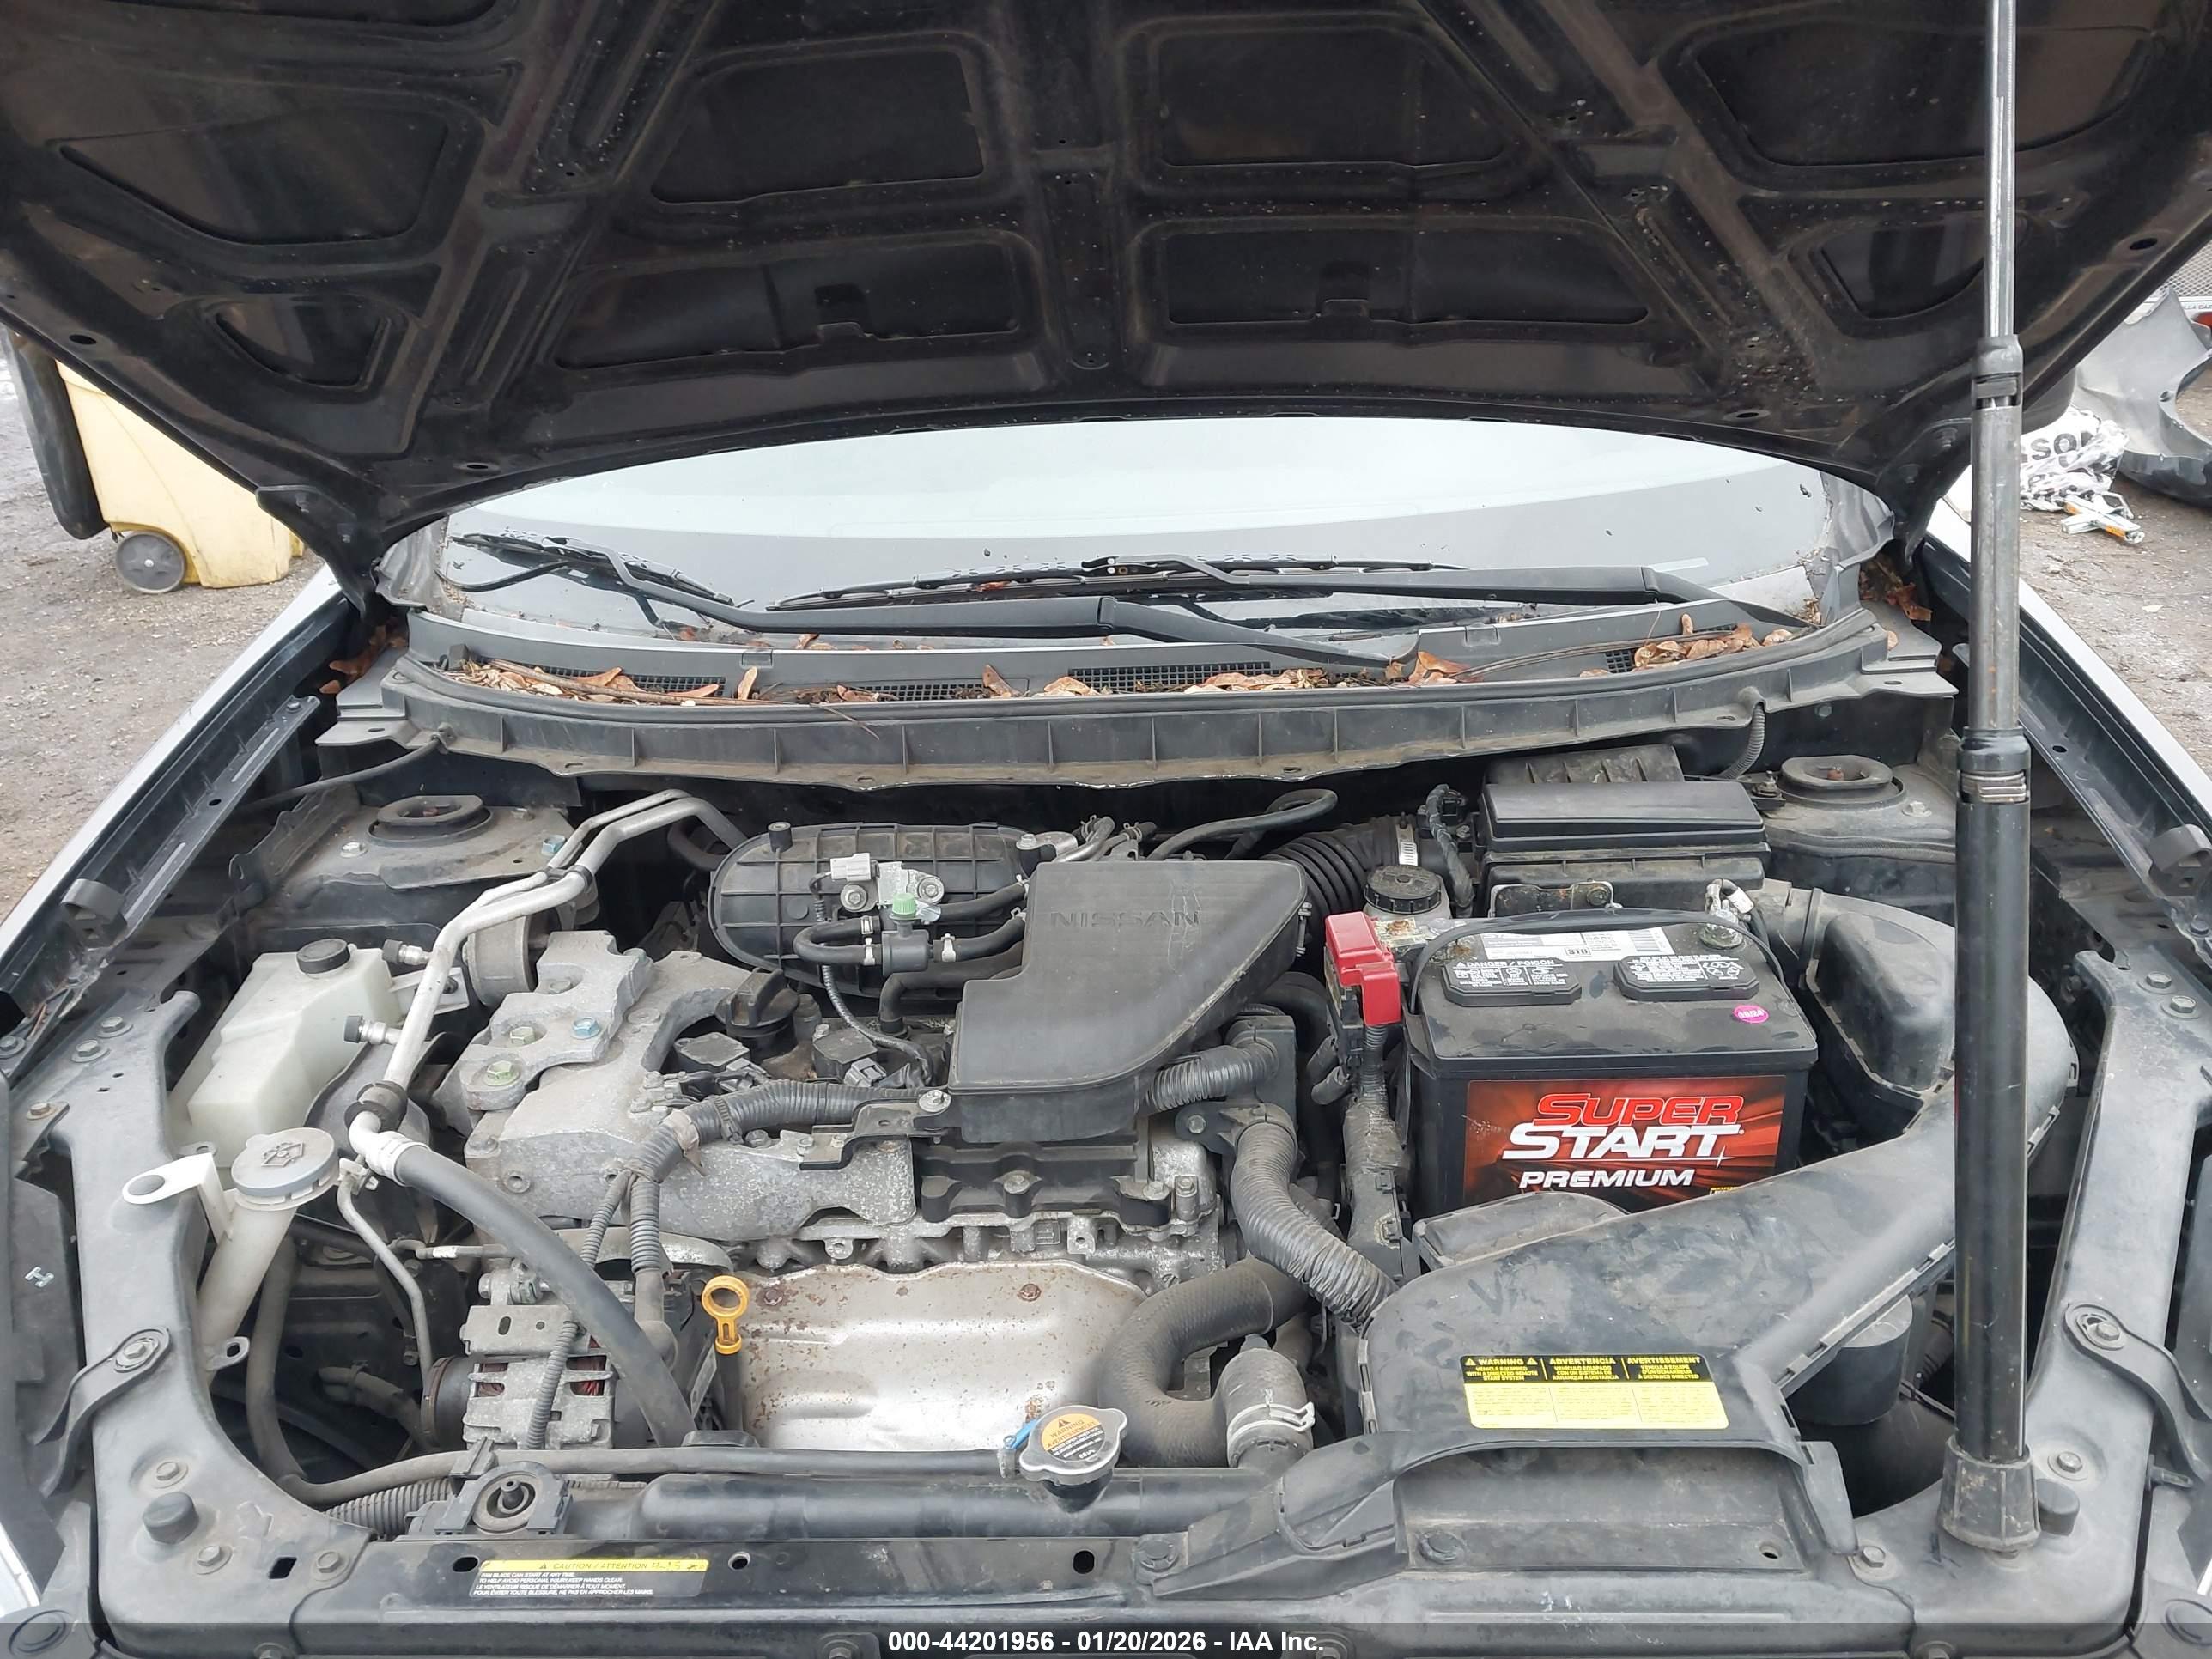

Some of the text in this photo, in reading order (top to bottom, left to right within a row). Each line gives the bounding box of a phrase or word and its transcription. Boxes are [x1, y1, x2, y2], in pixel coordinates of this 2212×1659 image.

[1051, 912, 1199, 927] NISSAN
[1533, 1093, 1744, 1126] SUPER
[1503, 1123, 1741, 1159] START
[1519, 1169, 1695, 1188] PREMIUM
[1050, 1419, 1084, 1438] WARNING
